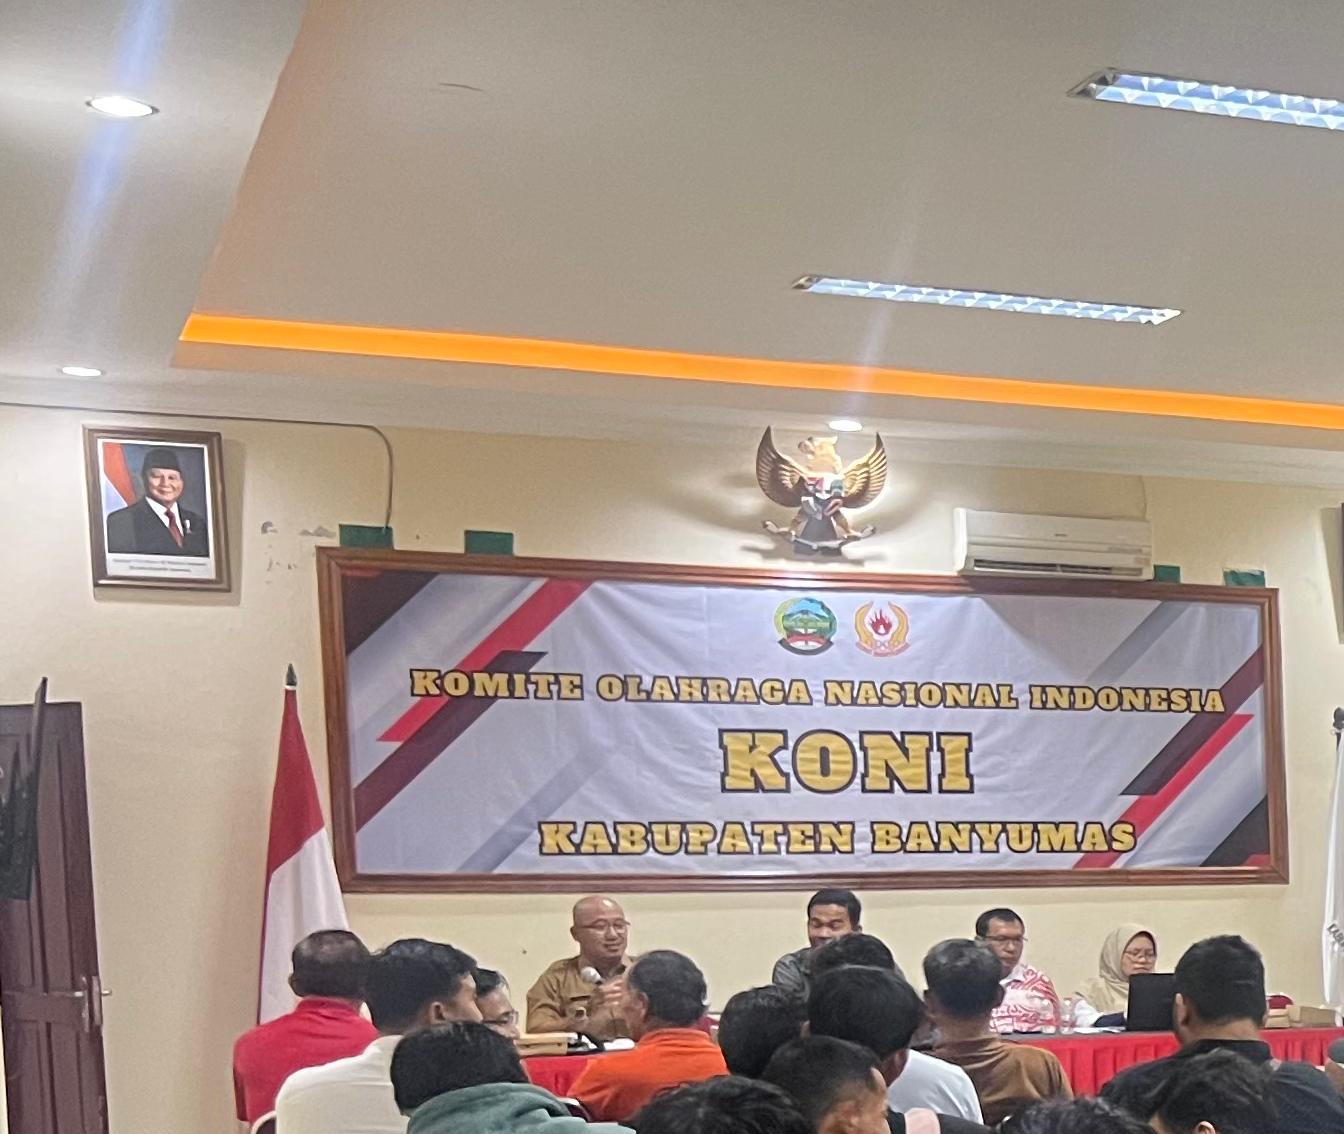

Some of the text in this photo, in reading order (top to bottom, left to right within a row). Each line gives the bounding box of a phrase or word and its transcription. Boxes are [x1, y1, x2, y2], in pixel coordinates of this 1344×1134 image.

[409, 668, 1226, 714] KOMITE OLAHRAGA NASIONAL INDONESIA
[718, 728, 976, 794] KONI
[538, 820, 1138, 856] KABUPATEN BANYUMAS
